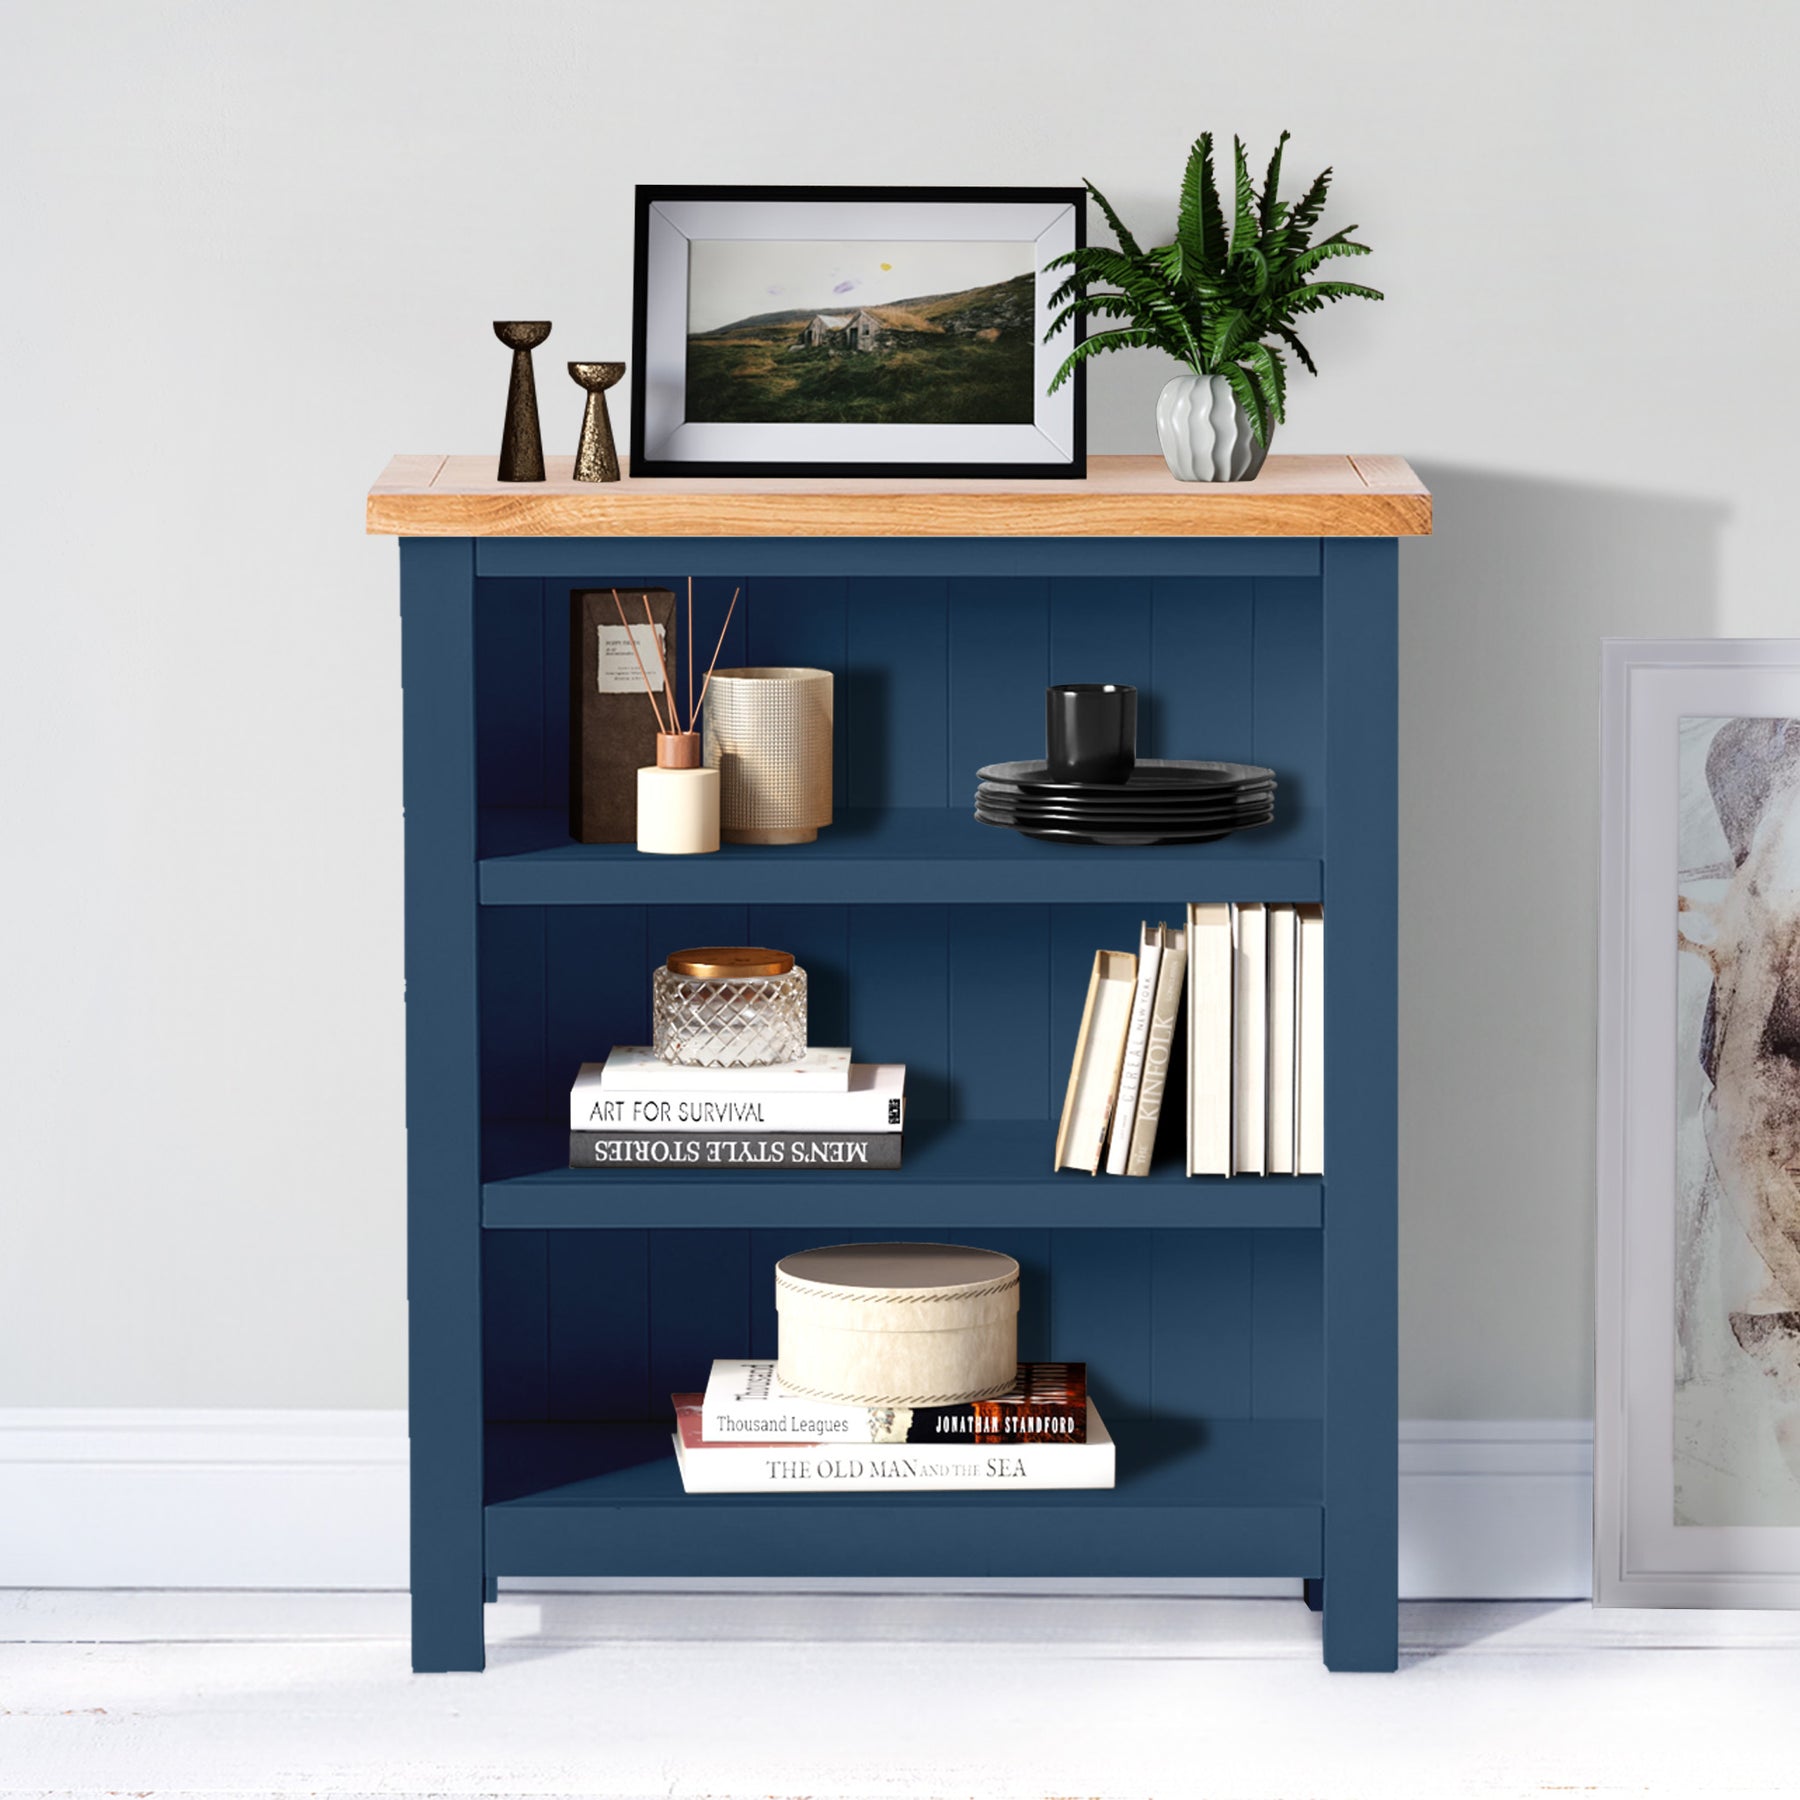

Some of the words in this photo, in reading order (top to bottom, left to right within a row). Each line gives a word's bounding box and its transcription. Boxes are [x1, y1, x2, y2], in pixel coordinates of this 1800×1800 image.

[1140, 977, 1152, 1004] YORK
[1137, 1008, 1147, 1031] NEW
[1122, 1041, 1143, 1102] CEREAL
[1138, 1014, 1174, 1121] KINFOLK
[590, 1101, 624, 1121] ART
[633, 1101, 671, 1122] FOR
[678, 1101, 764, 1122] SURVIVAL
[594, 1140, 700, 1163] STORIES
[706, 1141, 785, 1163] STYLE
[791, 1141, 869, 1163] MEN'S
[716, 1415, 787, 1432] Thousand
[791, 1416, 849, 1435] Leagues
[936, 1415, 999, 1434] JONATHAN
[1004, 1416, 1075, 1434] STANDFORD
[766, 1460, 812, 1479] THE
[816, 1460, 864, 1479] OLD
[869, 1459, 918, 1478] MAN
[919, 1464, 950, 1477] AND
[952, 1464, 980, 1477] THE
[986, 1458, 1028, 1478] SEA
